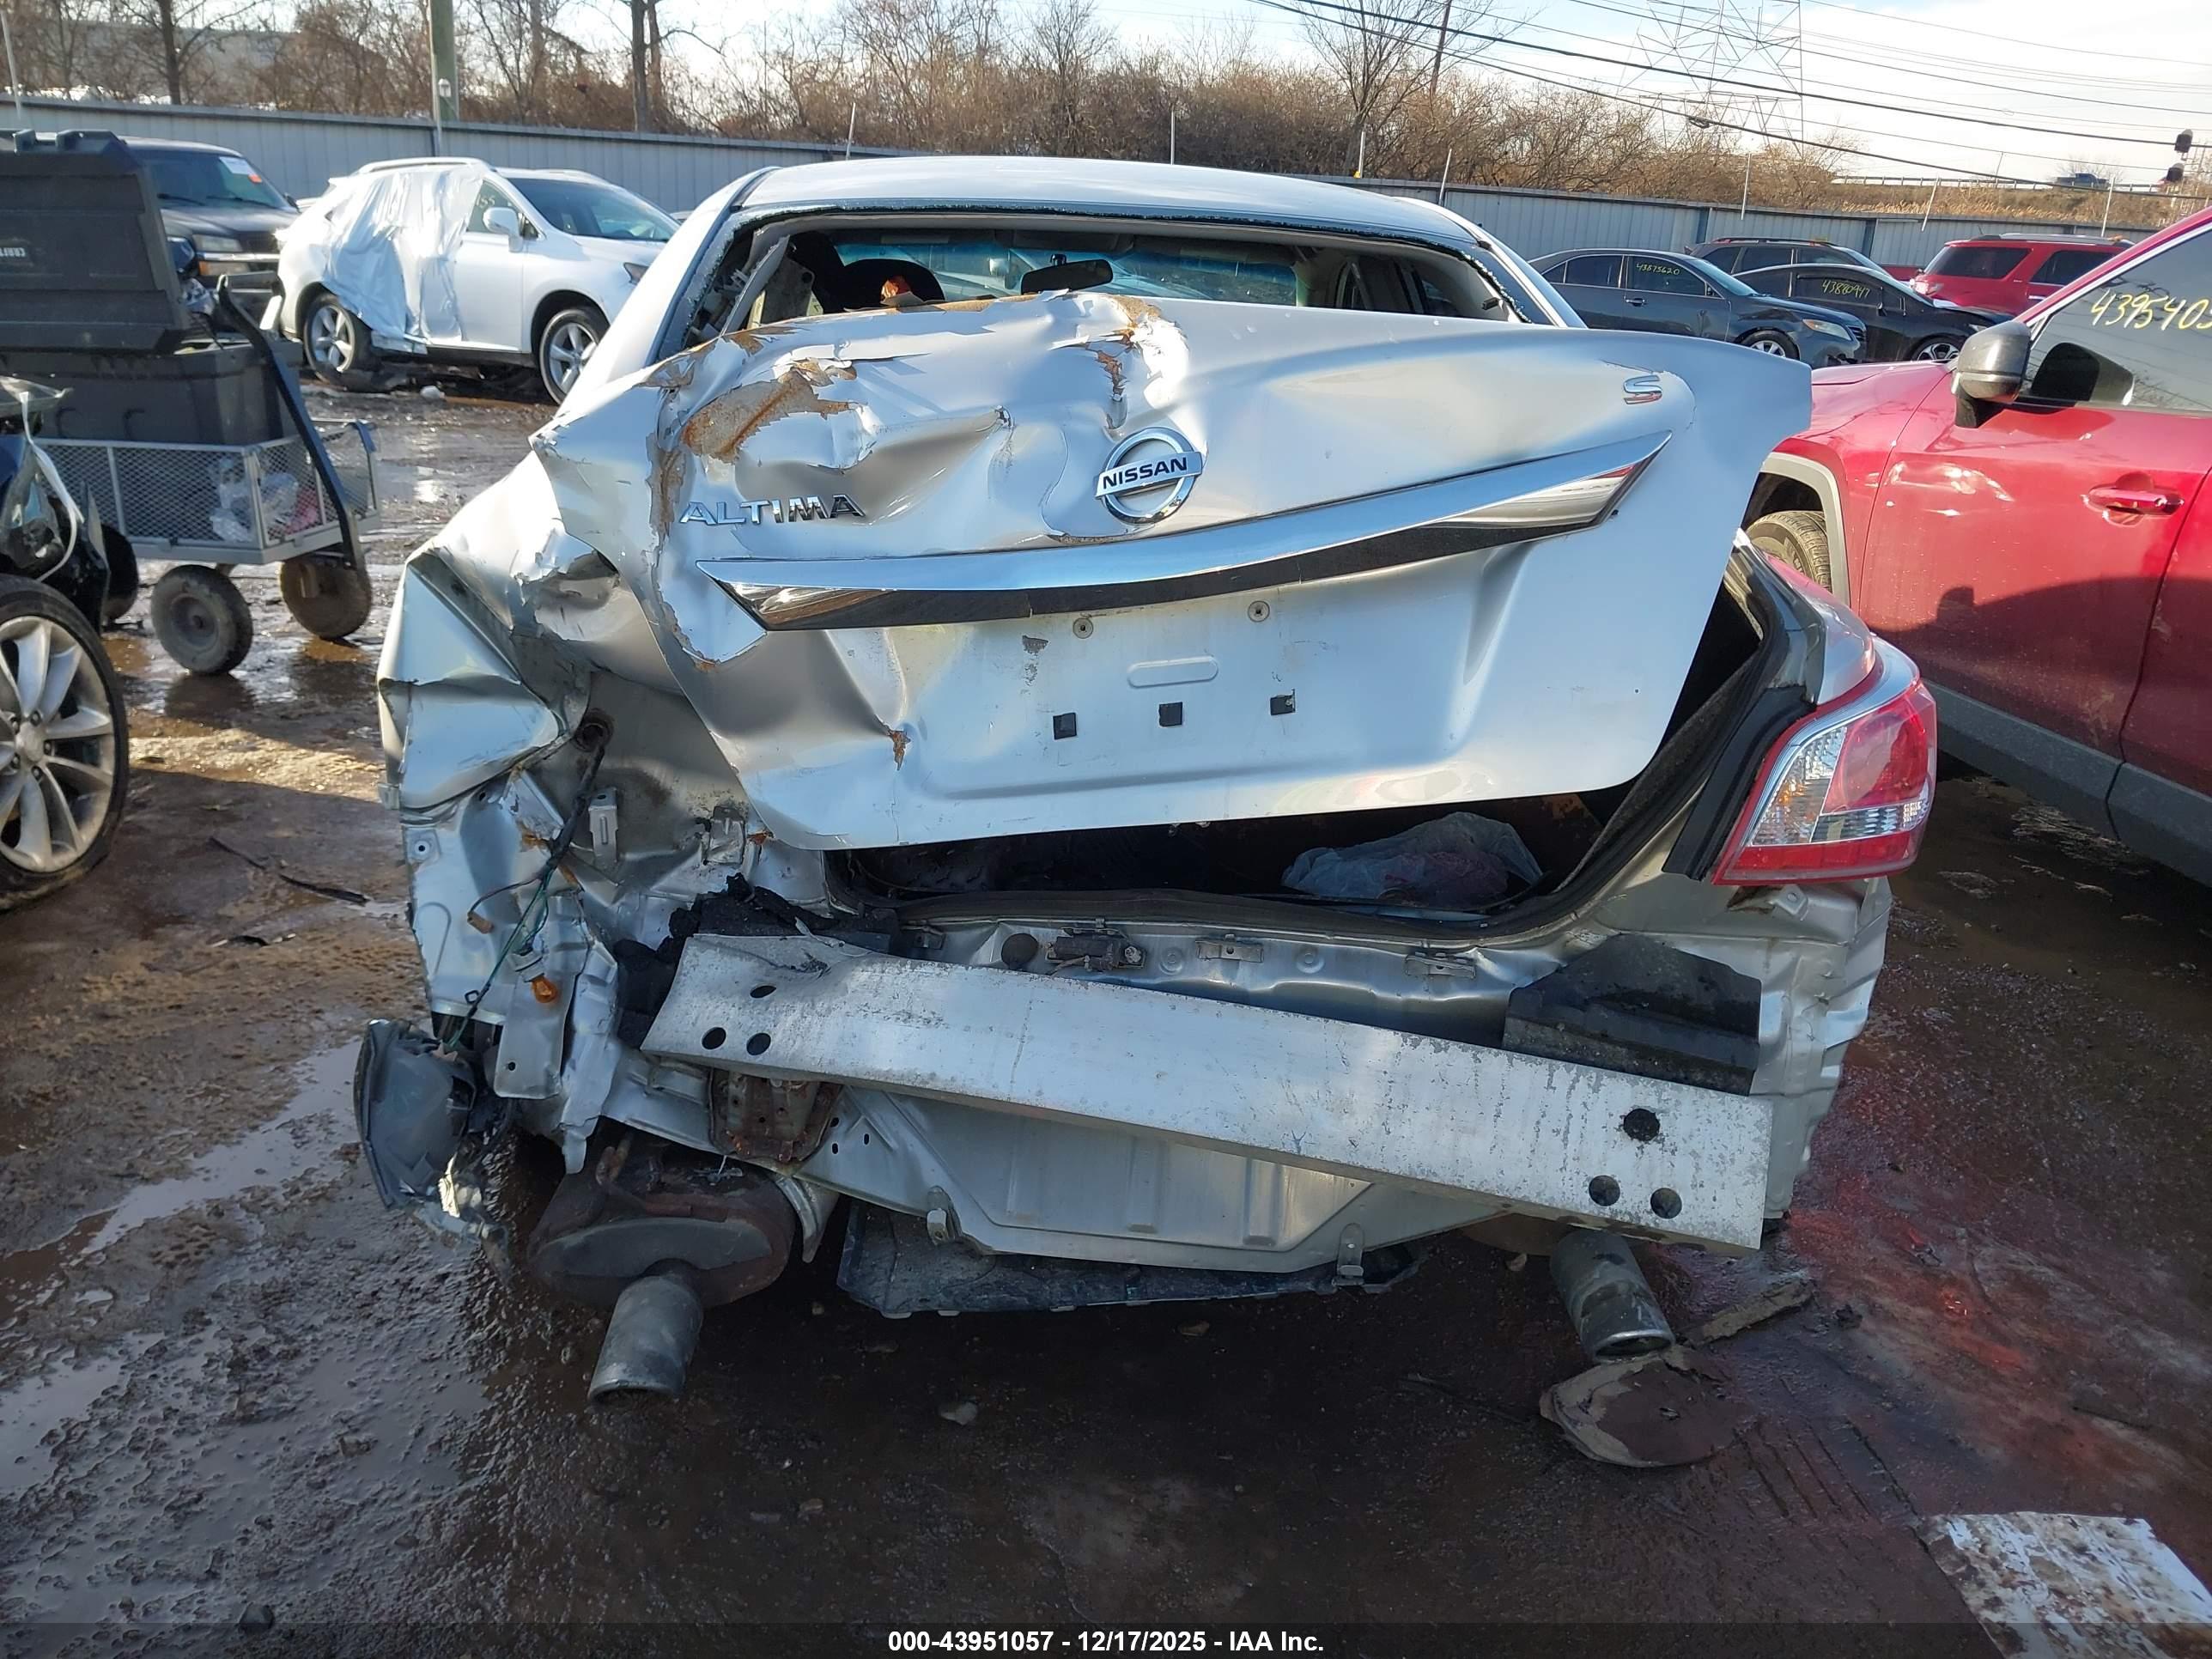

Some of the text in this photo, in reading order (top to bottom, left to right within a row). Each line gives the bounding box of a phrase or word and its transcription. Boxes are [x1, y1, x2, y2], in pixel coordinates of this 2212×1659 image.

[1822, 279, 1870, 299] 43880947
[1623, 374, 1663, 405] S
[1103, 456, 1188, 490] NISSAN
[679, 493, 866, 526] ALTIMA
